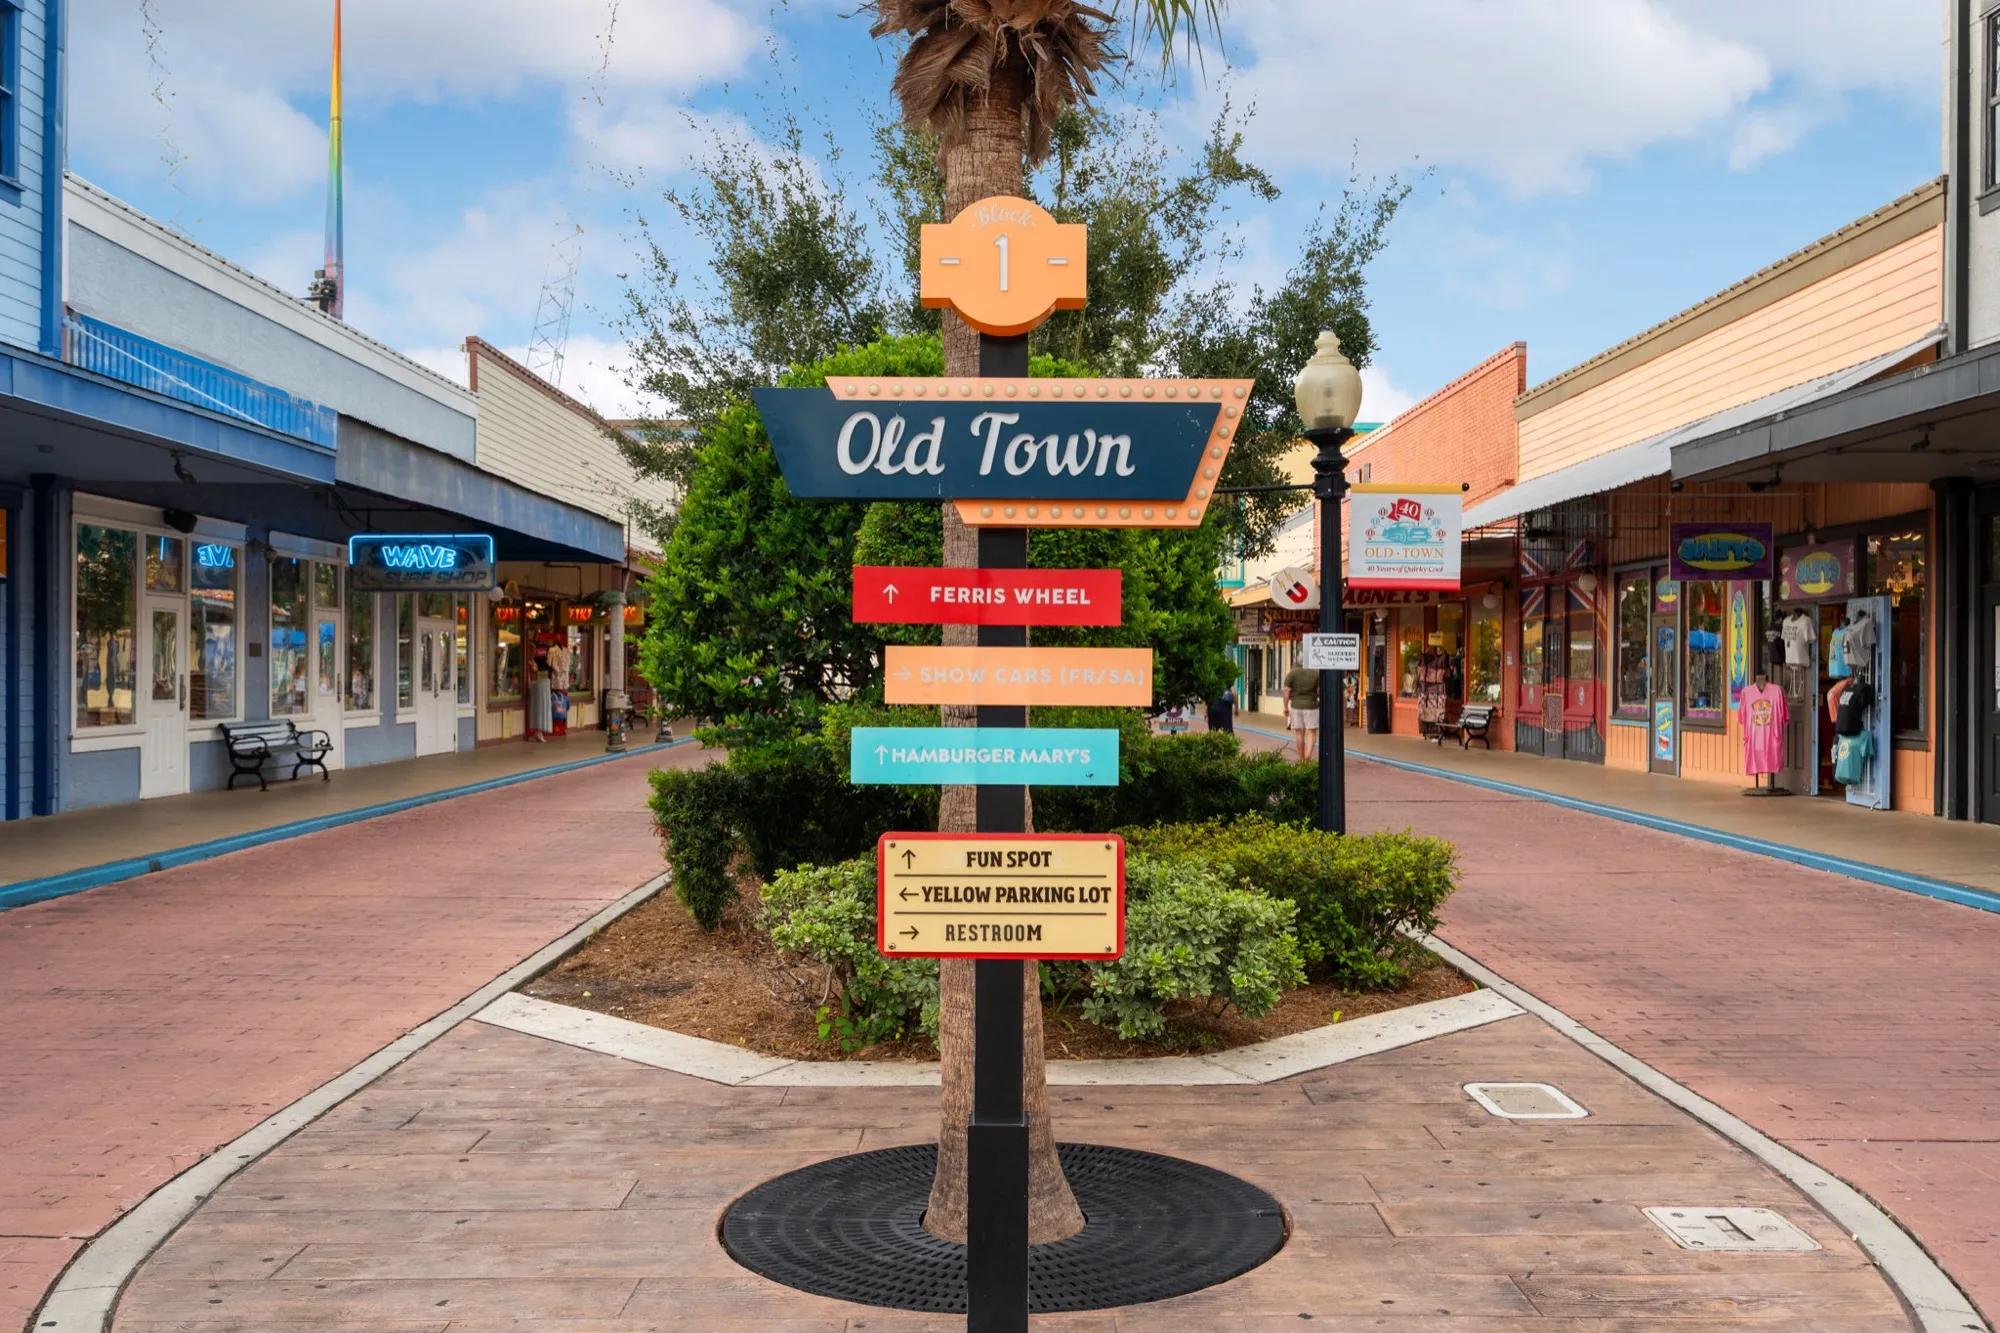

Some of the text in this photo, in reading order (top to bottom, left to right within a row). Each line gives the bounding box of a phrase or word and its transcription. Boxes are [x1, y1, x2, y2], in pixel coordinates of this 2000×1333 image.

[973, 203, 1032, 228] Block
[993, 234, 1009, 291] 1
[837, 411, 1137, 477] Old Town
[1398, 502, 1419, 518] 40
[382, 544, 457, 569] WAVE
[1364, 547, 1445, 559] OLD TOWN
[384, 571, 488, 584] SURF SHOP
[1403, 565, 1427, 574] Quirky
[930, 586, 1091, 605] FERRIS WHEEL
[1342, 588, 1430, 605] AGNETS
[920, 667, 1144, 686] SHOW CARS (FR/SA)
[891, 748, 1091, 764] HAMBURGER MARY'S
[966, 851, 1052, 868] FUN SPOT
[922, 886, 1111, 904] YELLOW PARKING LOT
[945, 924, 1042, 942] RESTROOM
